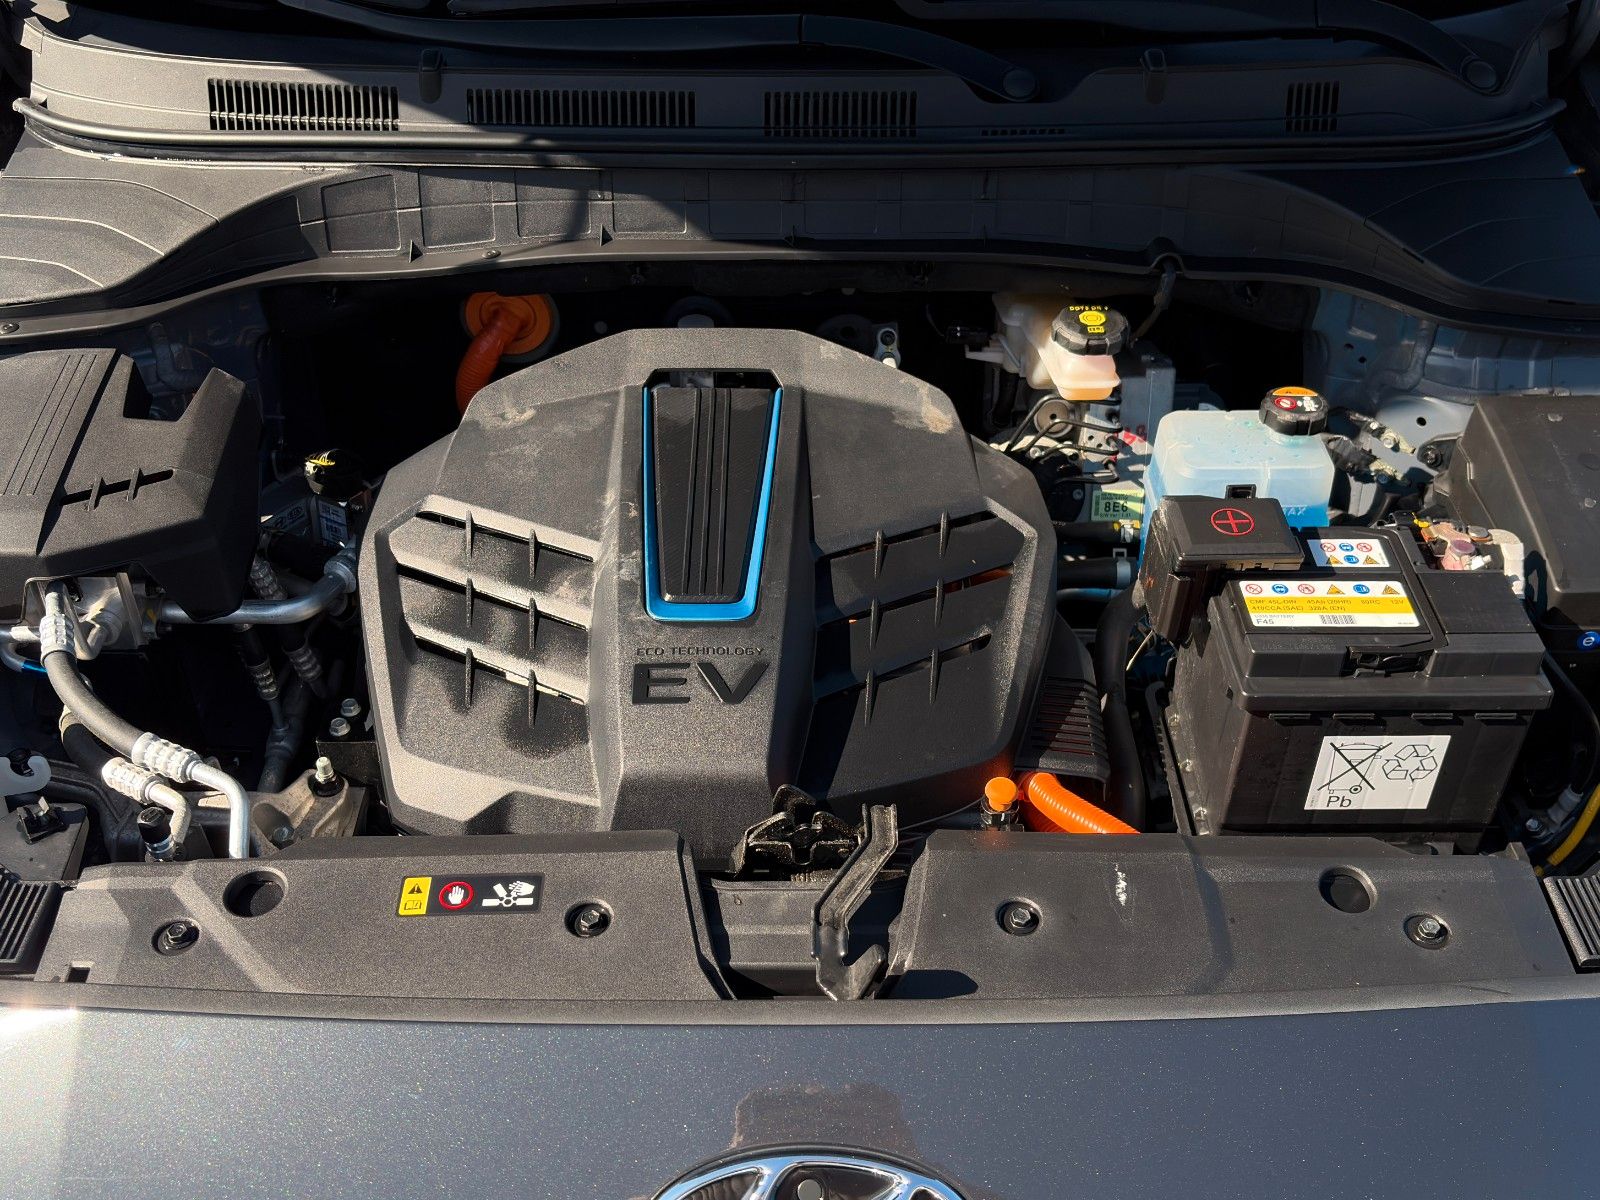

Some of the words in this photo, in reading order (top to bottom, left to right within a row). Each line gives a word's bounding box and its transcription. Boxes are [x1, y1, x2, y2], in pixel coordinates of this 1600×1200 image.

[1104, 501, 1128, 512] 8E6
[636, 646, 665, 656] ECO
[669, 646, 764, 656] TECHNOLOGY
[632, 662, 770, 704] EV
[1327, 796, 1352, 807] Pb
